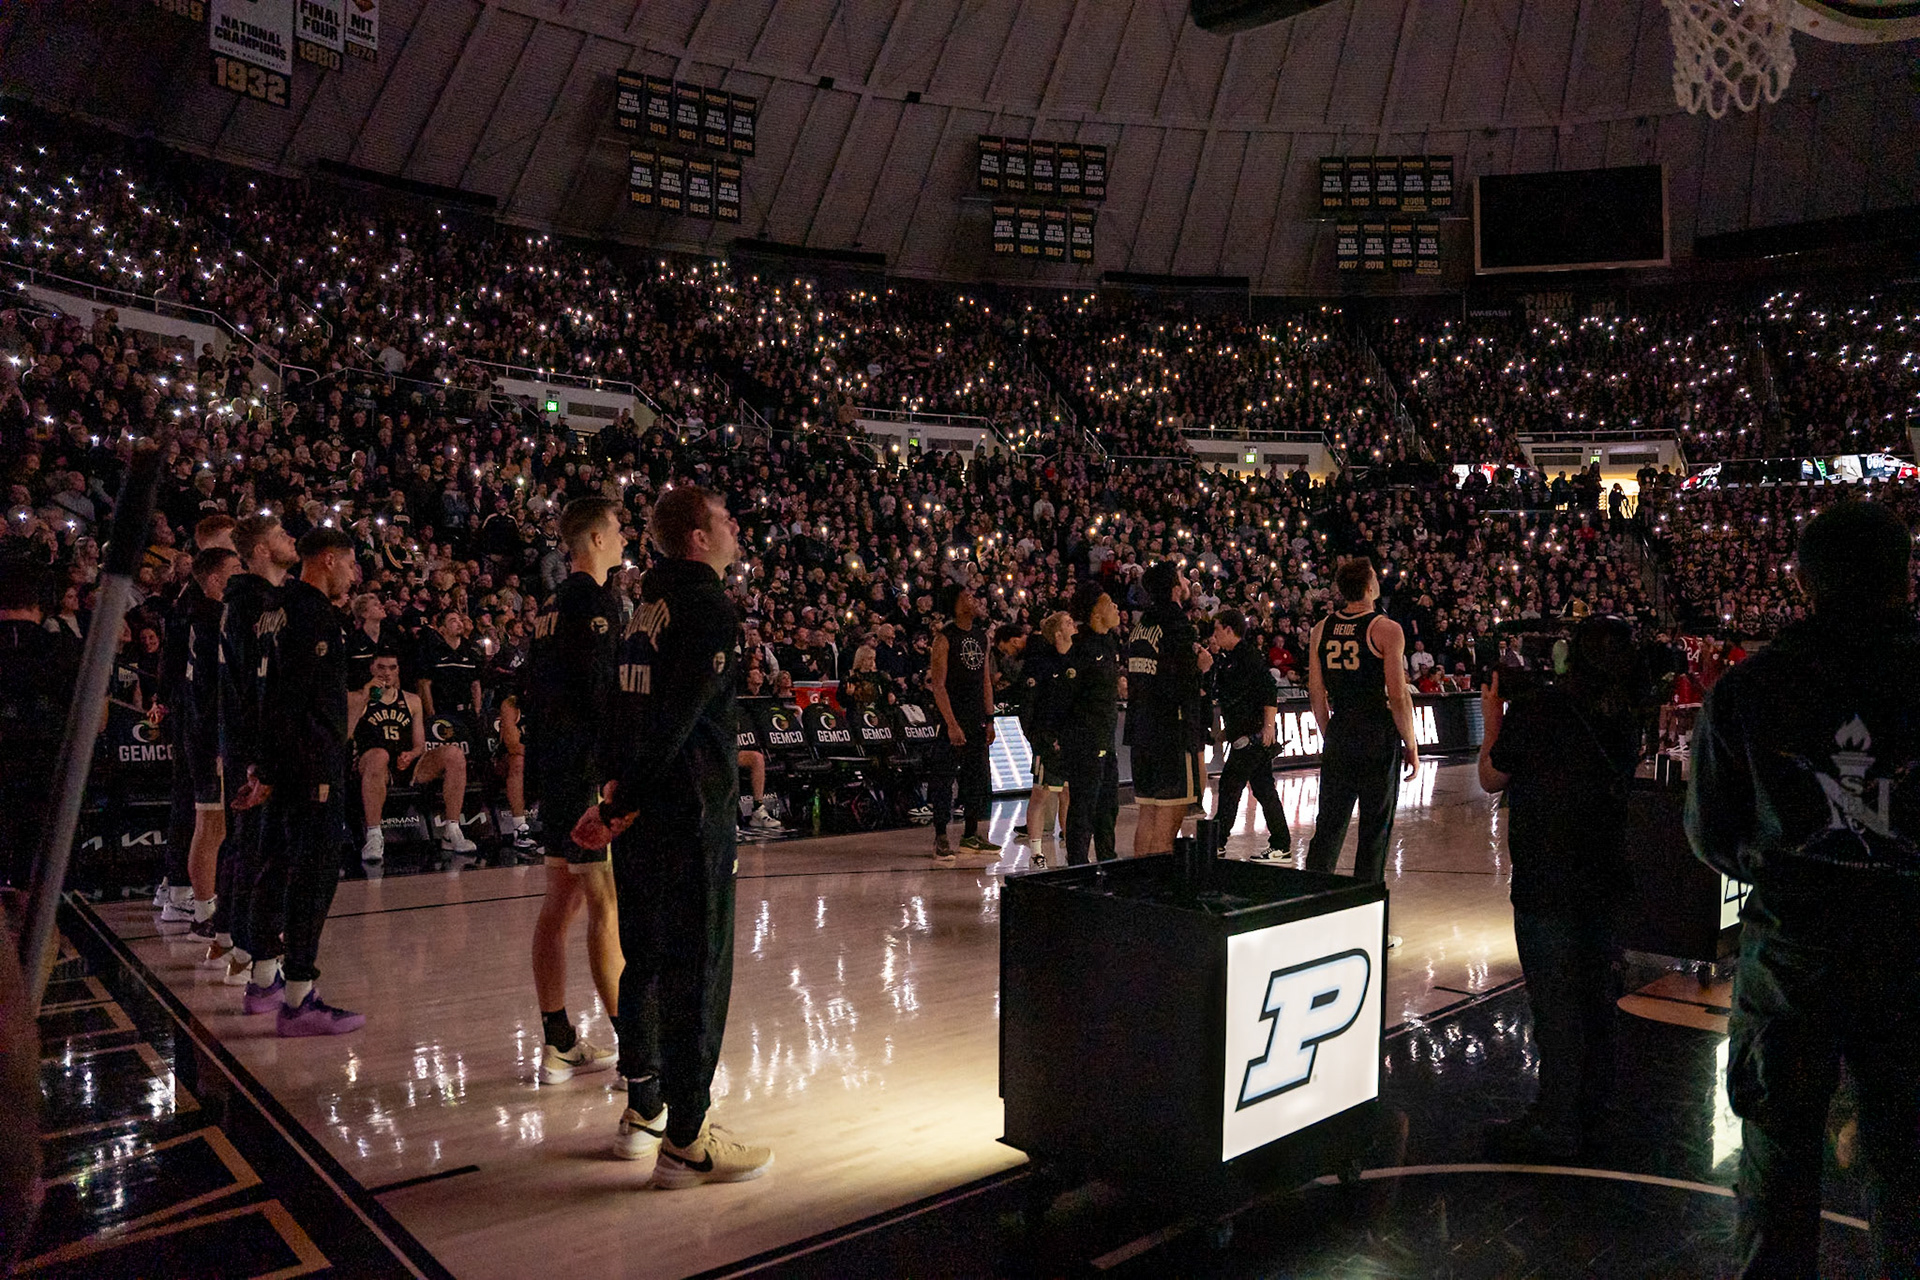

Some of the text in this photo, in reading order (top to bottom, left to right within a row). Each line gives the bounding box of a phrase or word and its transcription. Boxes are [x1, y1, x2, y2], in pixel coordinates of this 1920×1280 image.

[300, 1, 340, 27] FINAL
[303, 16, 338, 41] FOUR
[351, 13, 373, 33] NIT
[221, 14, 281, 47] NATIONAL
[214, 26, 286, 61] CHAMPIONS
[298, 40, 341, 71] 1980
[214, 56, 286, 107] 1932
[620, 116, 636, 129] 1911
[678, 128, 696, 140] 1921
[706, 134, 726, 146] 1922
[631, 191, 652, 204] 1928
[660, 196, 681, 209] 1930
[1431, 197, 1451, 206] 2010
[690, 202, 710, 214] 1932
[718, 206, 738, 218] 1934
[1338, 260, 1358, 270] 2017
[1333, 623, 1357, 636] HEIDE
[1326, 640, 1360, 671] 23
[1686, 646, 1700, 663] 24
[367, 708, 411, 727] PURDUE
[382, 725, 401, 741] 15
[769, 730, 804, 745] GEMCO
[817, 729, 851, 743] GEMCO
[861, 727, 892, 740] GEMCO
[904, 725, 935, 739] GEMCO
[1235, 948, 1371, 1112] P
